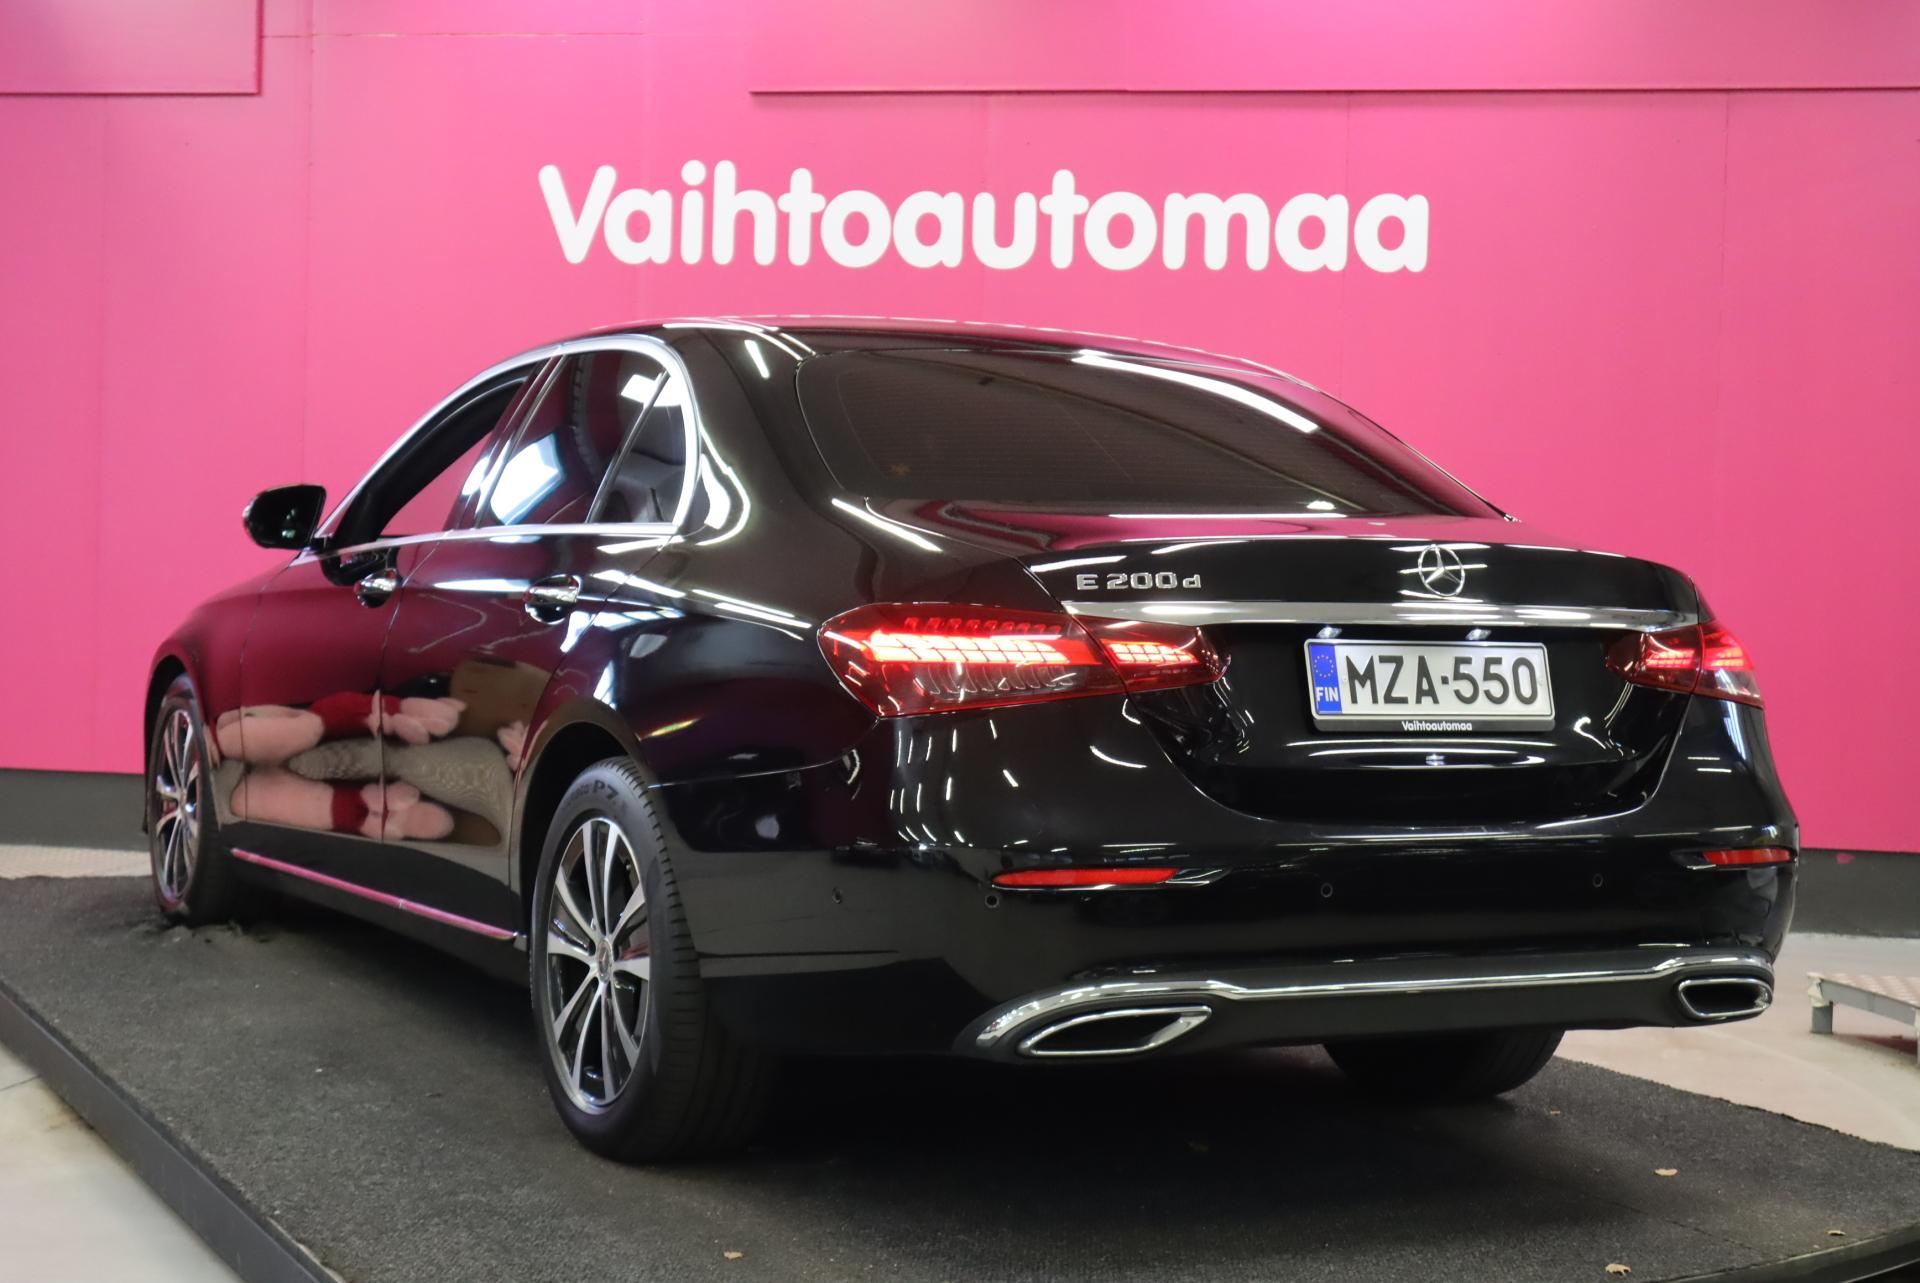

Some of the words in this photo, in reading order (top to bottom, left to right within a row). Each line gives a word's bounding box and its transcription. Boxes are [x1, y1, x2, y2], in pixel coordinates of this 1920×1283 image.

[538, 159, 1430, 273] Vaihtoautomaa
[1076, 573, 1099, 590] E
[1345, 655, 1538, 705] MZA-550
[1316, 686, 1340, 703] FIN
[1401, 720, 1473, 731] Vaihtoautomaa
